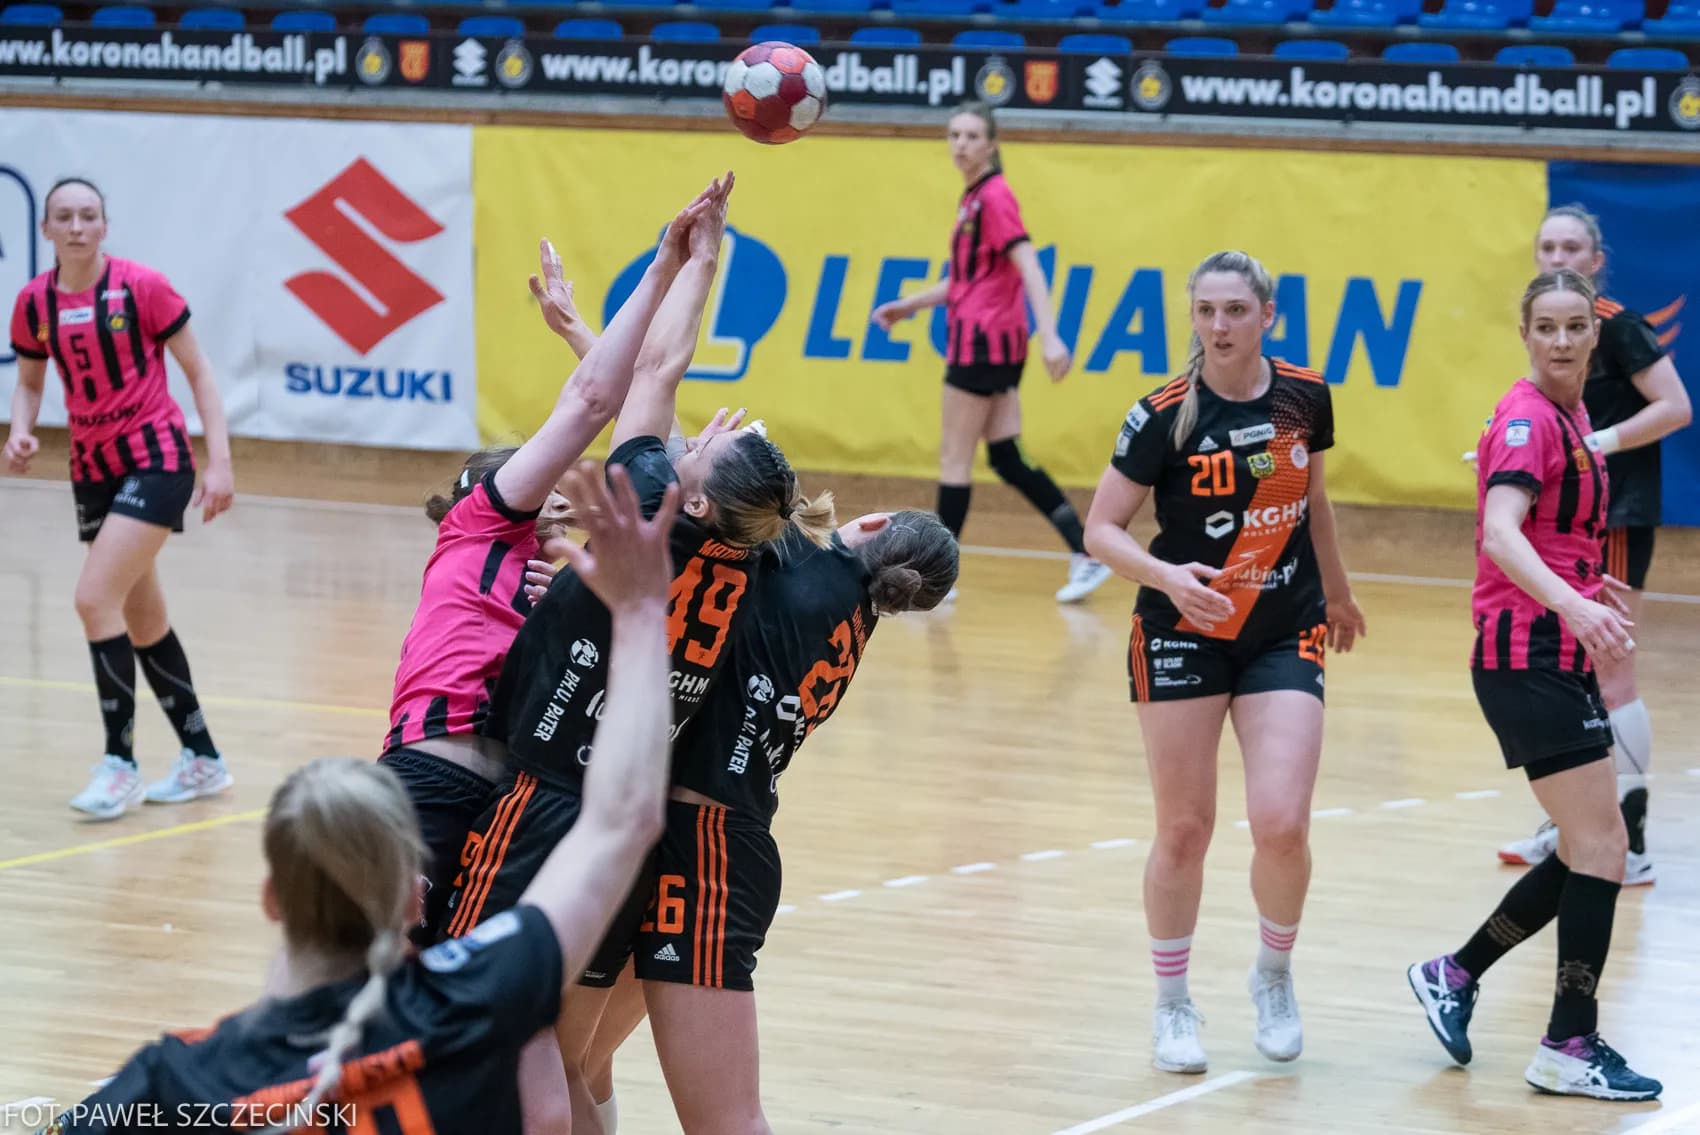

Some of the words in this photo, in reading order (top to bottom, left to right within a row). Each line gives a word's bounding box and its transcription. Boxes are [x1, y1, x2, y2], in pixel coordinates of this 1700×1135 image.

[1181, 67, 1657, 128] www.koronahandball.pl
[803, 244, 1424, 388] LEIAAN
[70, 333, 91, 370] 5
[285, 362, 452, 402] SUZUKI
[1188, 449, 1235, 496] 20
[667, 670, 710, 695] GHM
[533, 701, 565, 742] PATER
[728, 734, 754, 774] PATER
[654, 953, 681, 962] adidas
